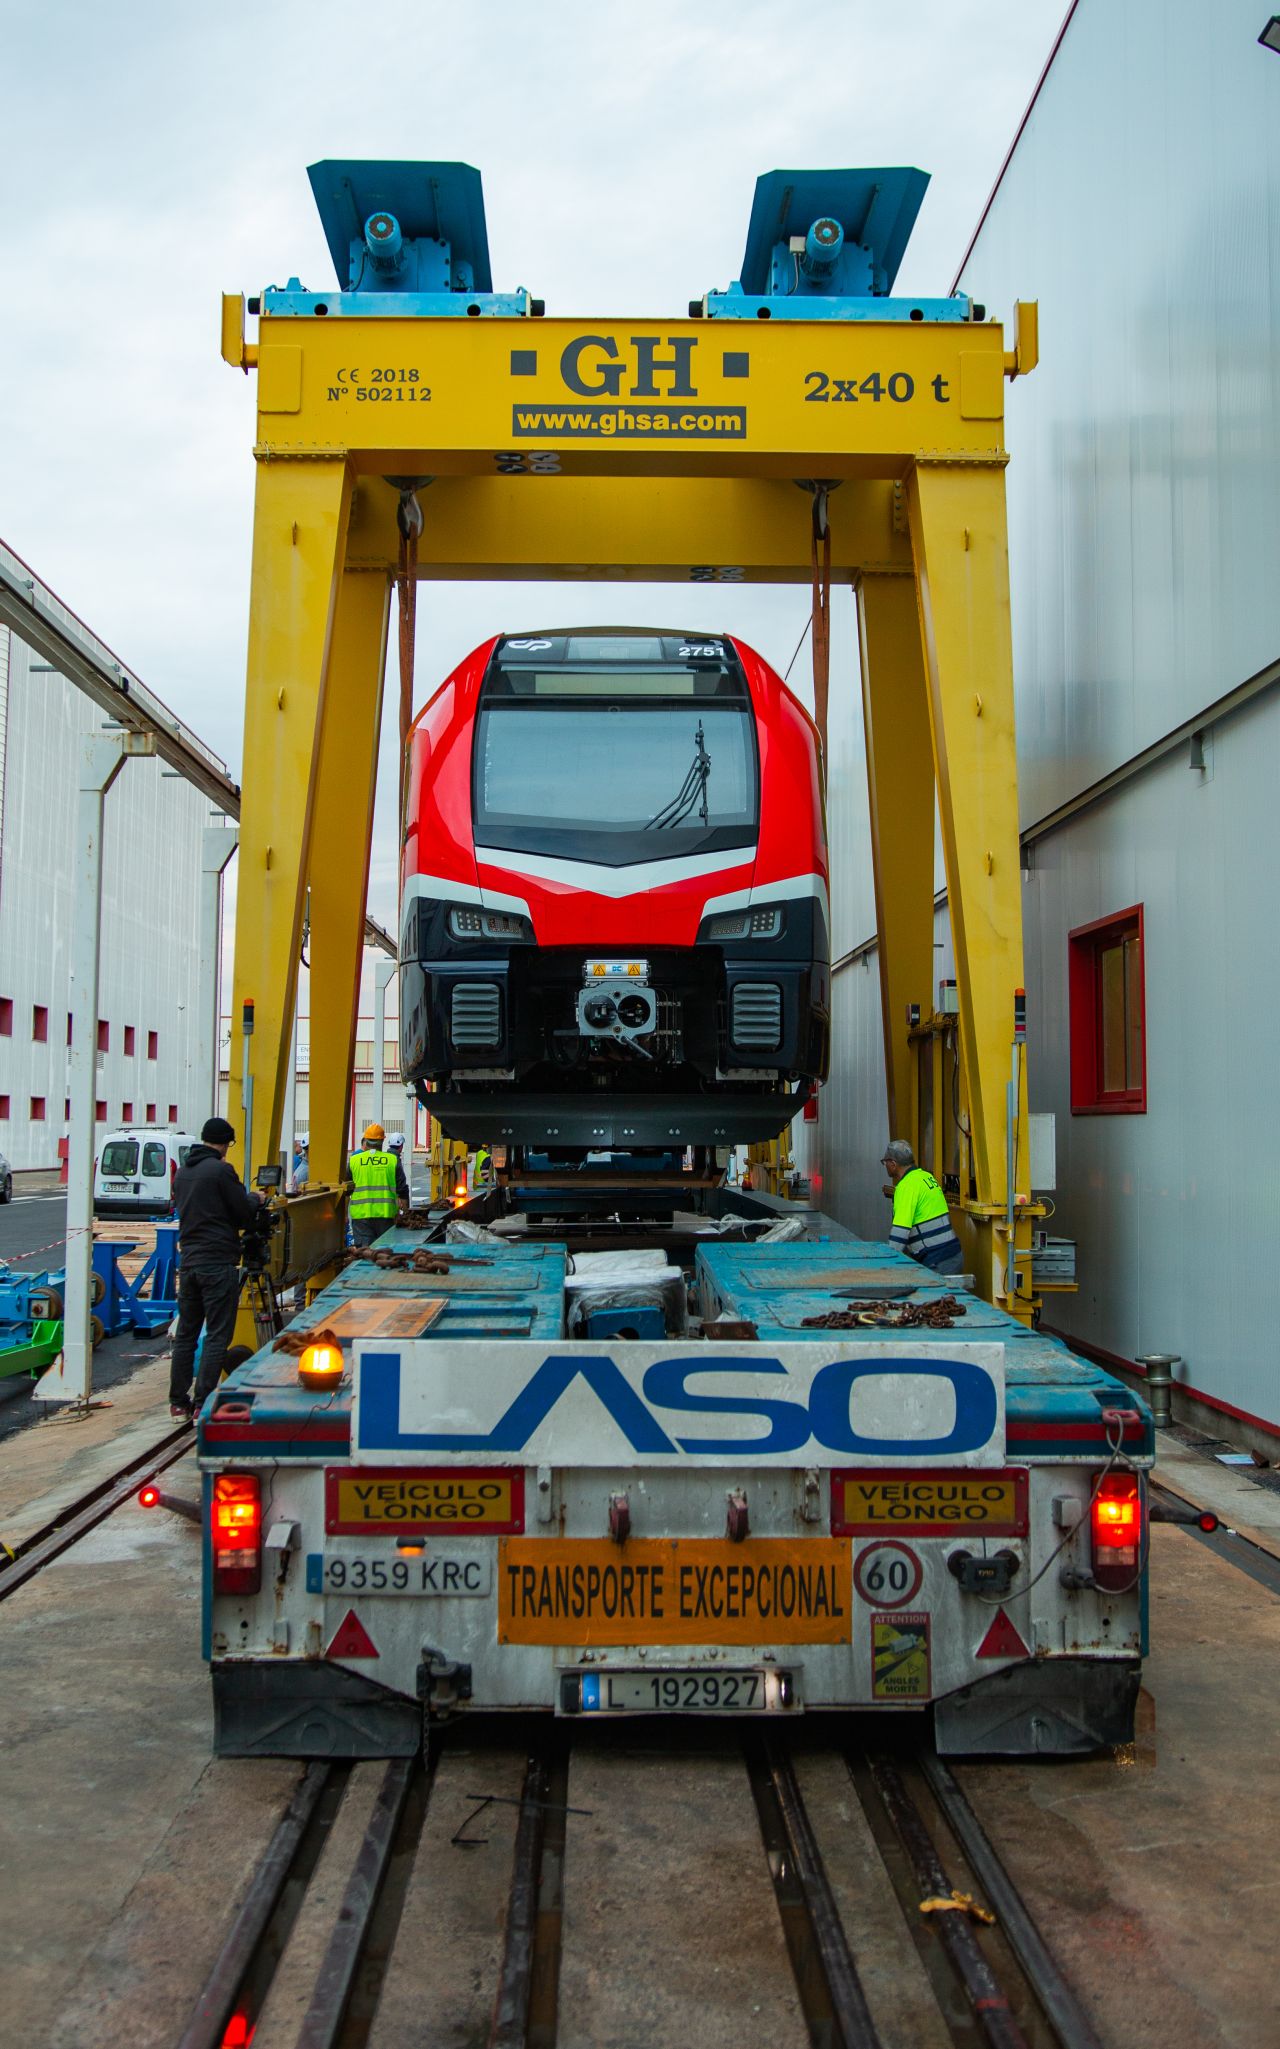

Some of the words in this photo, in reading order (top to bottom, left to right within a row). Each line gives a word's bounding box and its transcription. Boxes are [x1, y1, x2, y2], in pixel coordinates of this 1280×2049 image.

[371, 368, 420, 383] 2018
[560, 335, 698, 397] GH
[356, 387, 432, 401] 502112
[804, 371, 915, 403] 2x40
[931, 374, 950, 403] t
[517, 409, 742, 435] www.ghsa.com
[678, 646, 725, 657] 2751
[360, 1156, 389, 1166] LASO
[358, 1353, 998, 1457] LASO
[354, 1482, 502, 1501] VEÍCULO
[858, 1483, 1005, 1501] VEÍCULO
[364, 1503, 485, 1519] LONGO
[867, 1504, 988, 1520] LONGO
[330, 1560, 409, 1589] 9359
[422, 1562, 481, 1590] KRC
[866, 1560, 908, 1591] 60
[507, 1564, 664, 1618] TRANSPORTE
[679, 1564, 844, 1618] EXCEPCIONAL
[874, 1615, 927, 1624] ATTENTION
[651, 1676, 759, 1707] 192927
